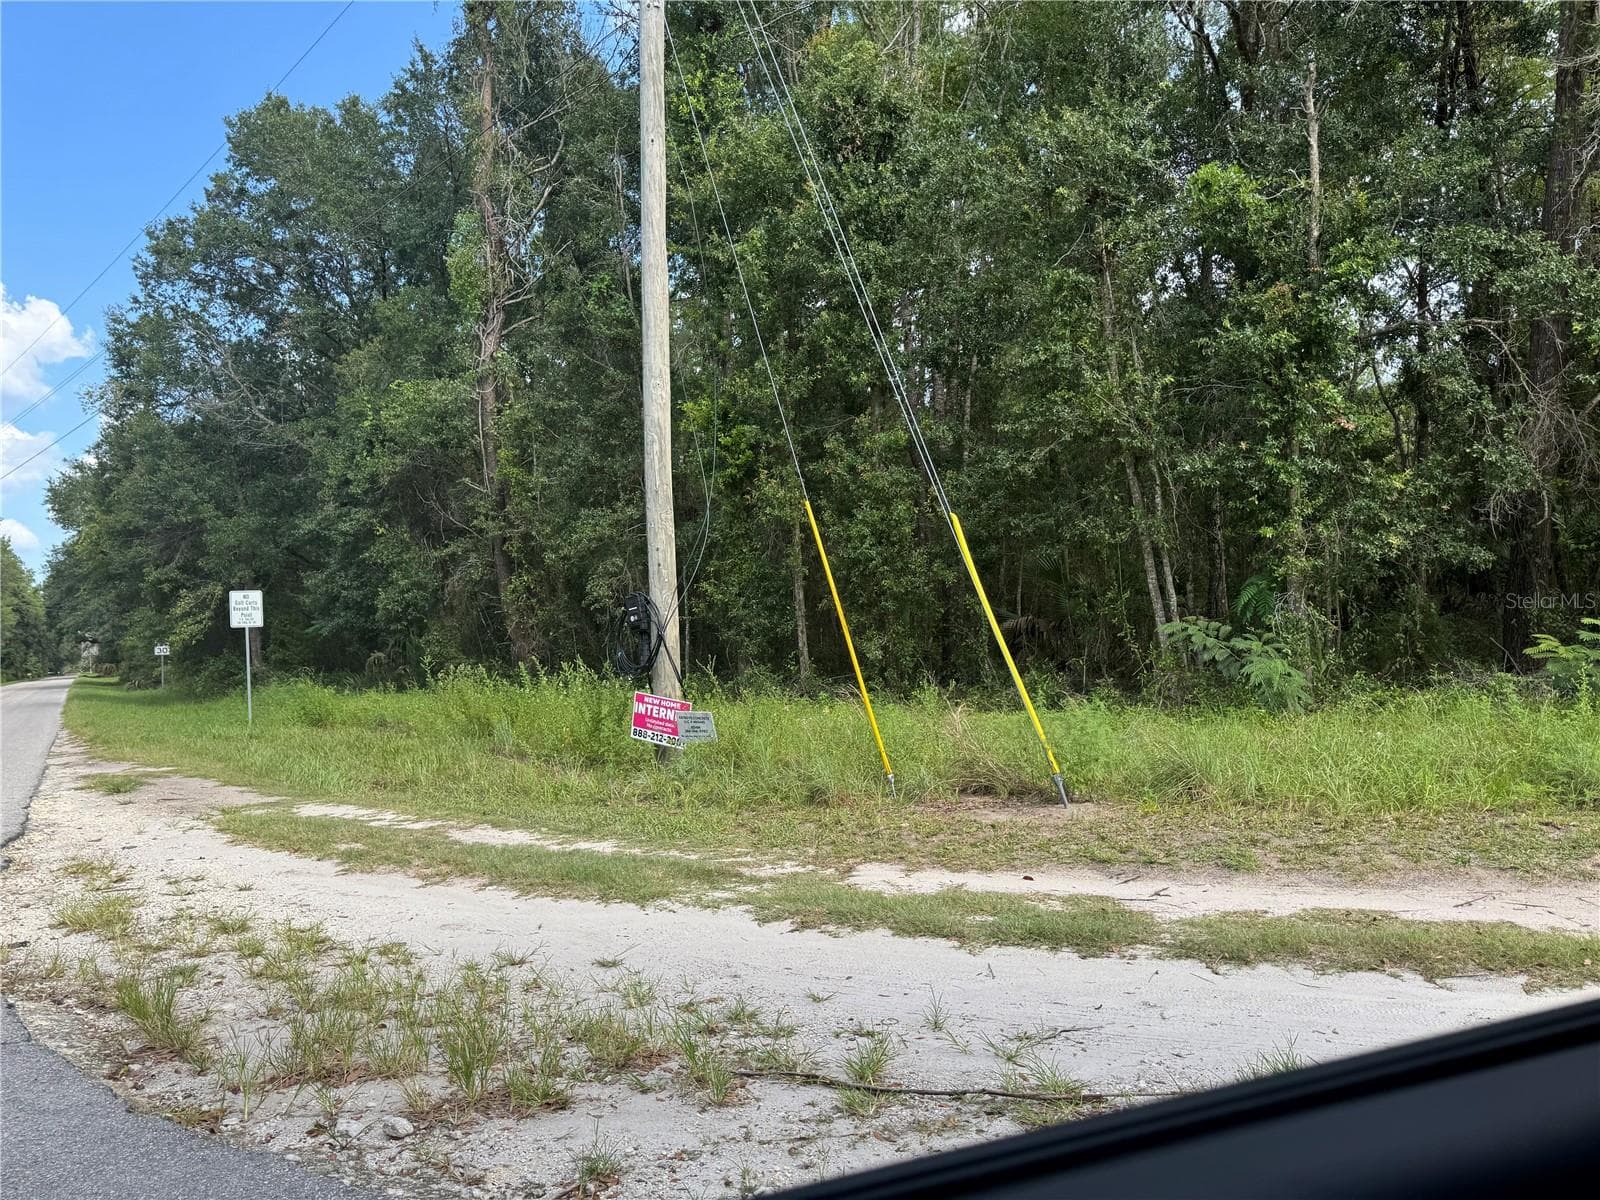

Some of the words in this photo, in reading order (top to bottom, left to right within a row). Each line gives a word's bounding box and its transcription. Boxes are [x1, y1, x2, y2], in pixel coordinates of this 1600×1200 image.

[644, 696, 661, 705] NEW
[661, 699, 681, 710] HOME
[635, 702, 677, 721] INTERN
